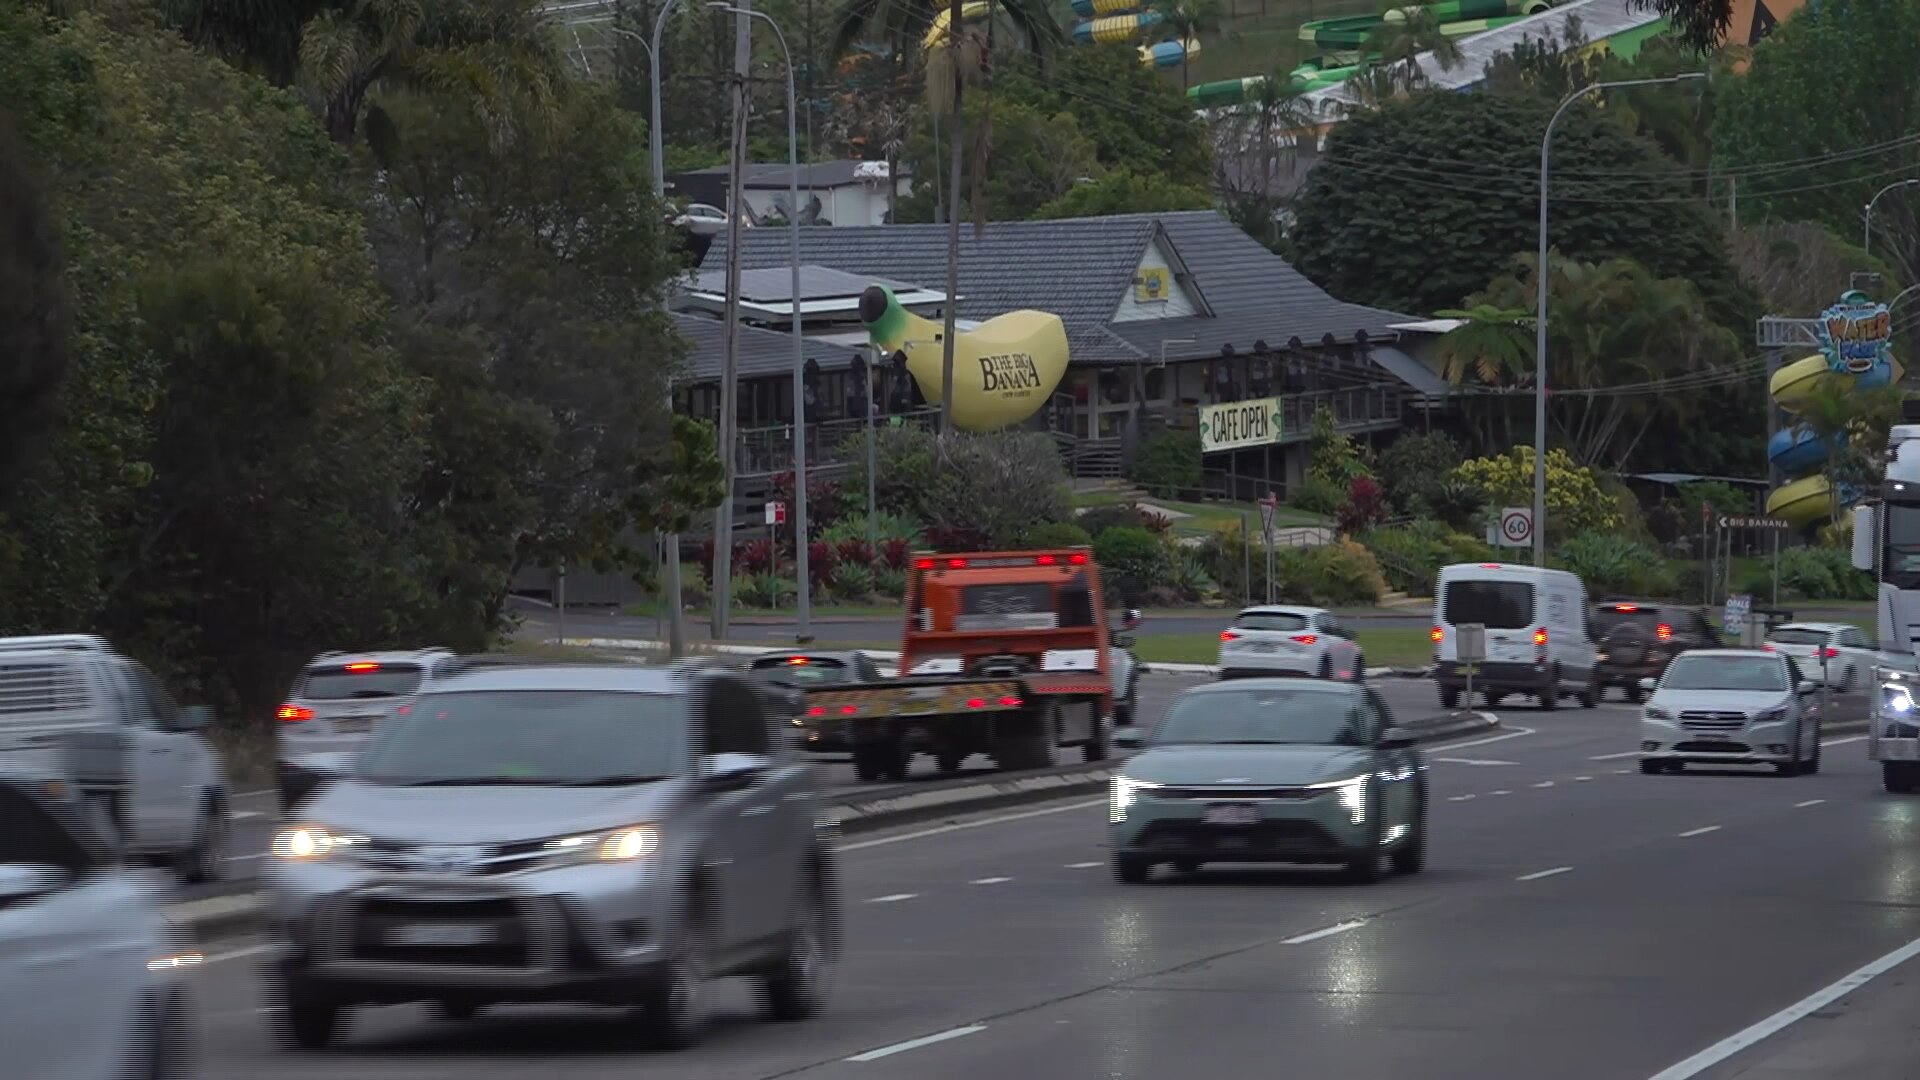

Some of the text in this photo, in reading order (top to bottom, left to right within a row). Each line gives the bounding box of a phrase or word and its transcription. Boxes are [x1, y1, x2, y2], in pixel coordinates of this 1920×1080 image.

[1827, 312, 1889, 342] WATER
[979, 355, 1040, 391] BANANA
[991, 353, 1028, 370] THE BIG
[1213, 405, 1268, 443] CAFE OPEN
[1508, 520, 1526, 534] 60
[1730, 518, 1789, 528] BIG BANANA
